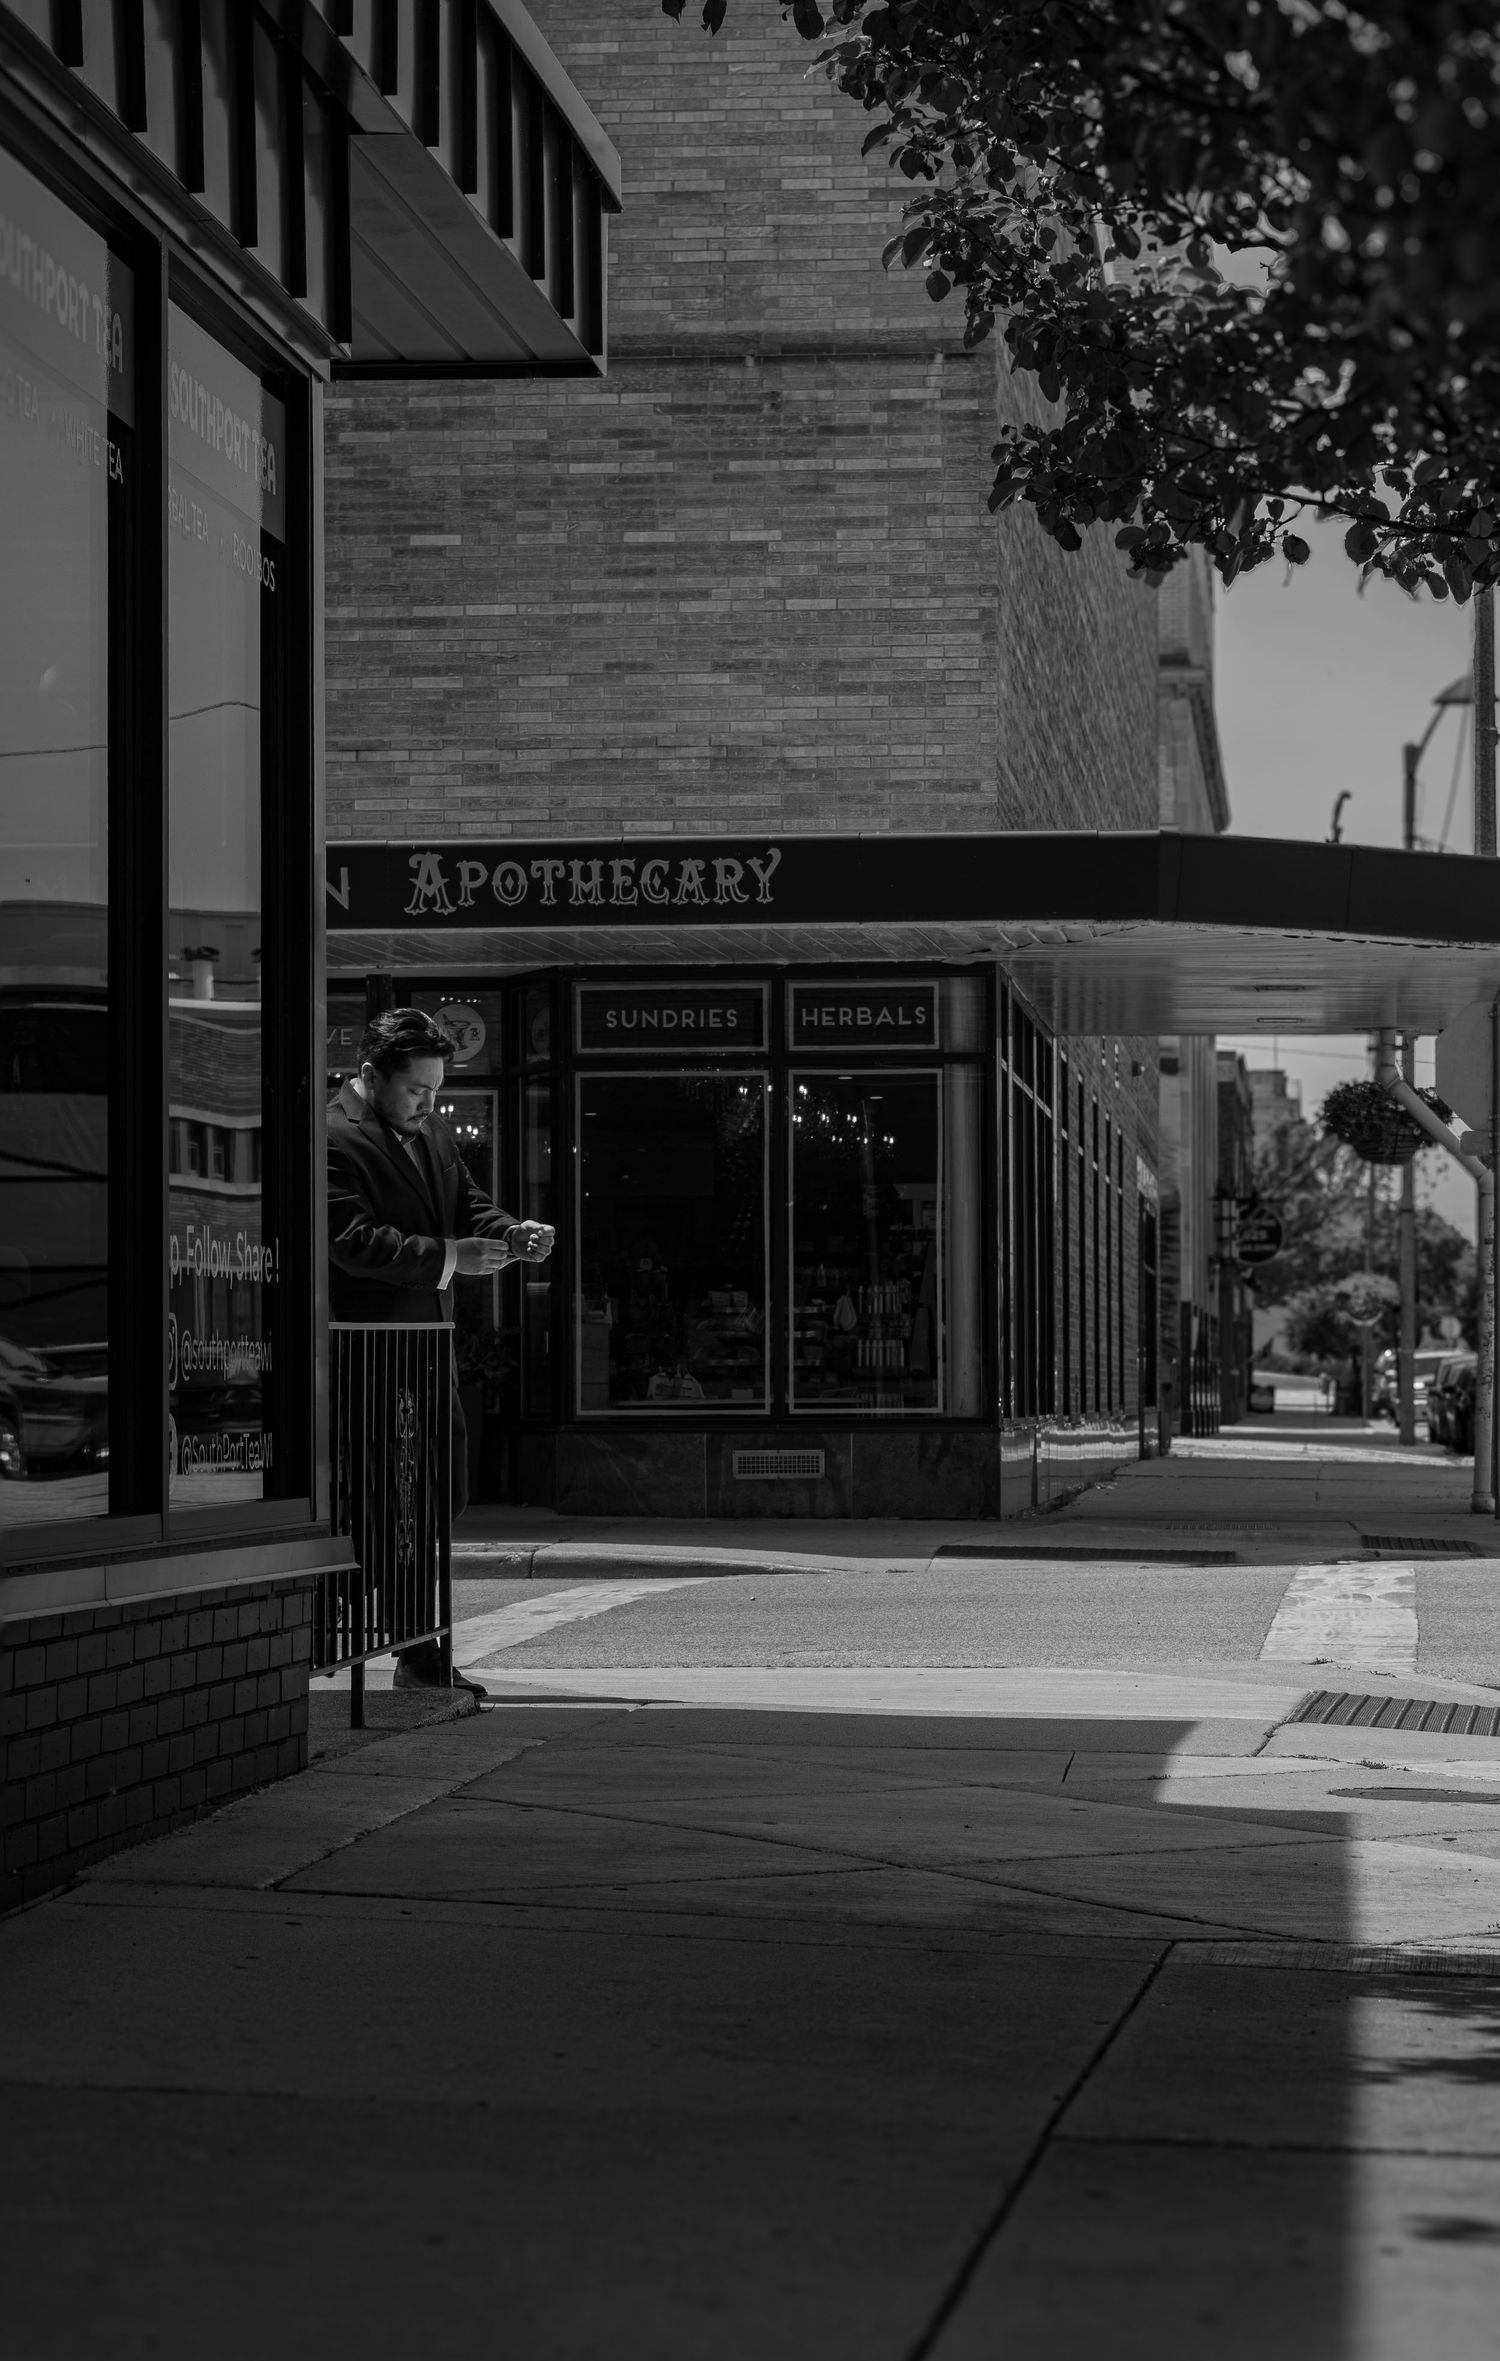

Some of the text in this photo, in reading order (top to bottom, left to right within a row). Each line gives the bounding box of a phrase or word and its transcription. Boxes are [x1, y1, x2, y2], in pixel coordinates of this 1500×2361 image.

[92, 293, 124, 374] TEA
[169, 360, 277, 496] SOUTHPORT TEA
[102, 435, 124, 485] TEA
[191, 501, 209, 545] TEA
[233, 530, 276, 593] ROOIBOS
[605, 1008, 738, 1030] SUNDRIES
[801, 1004, 927, 1028] HERBALS
[186, 1225, 233, 1290] Follow,
[236, 1231, 280, 1283] Share!
[180, 1328, 273, 1382] @southportteawi
